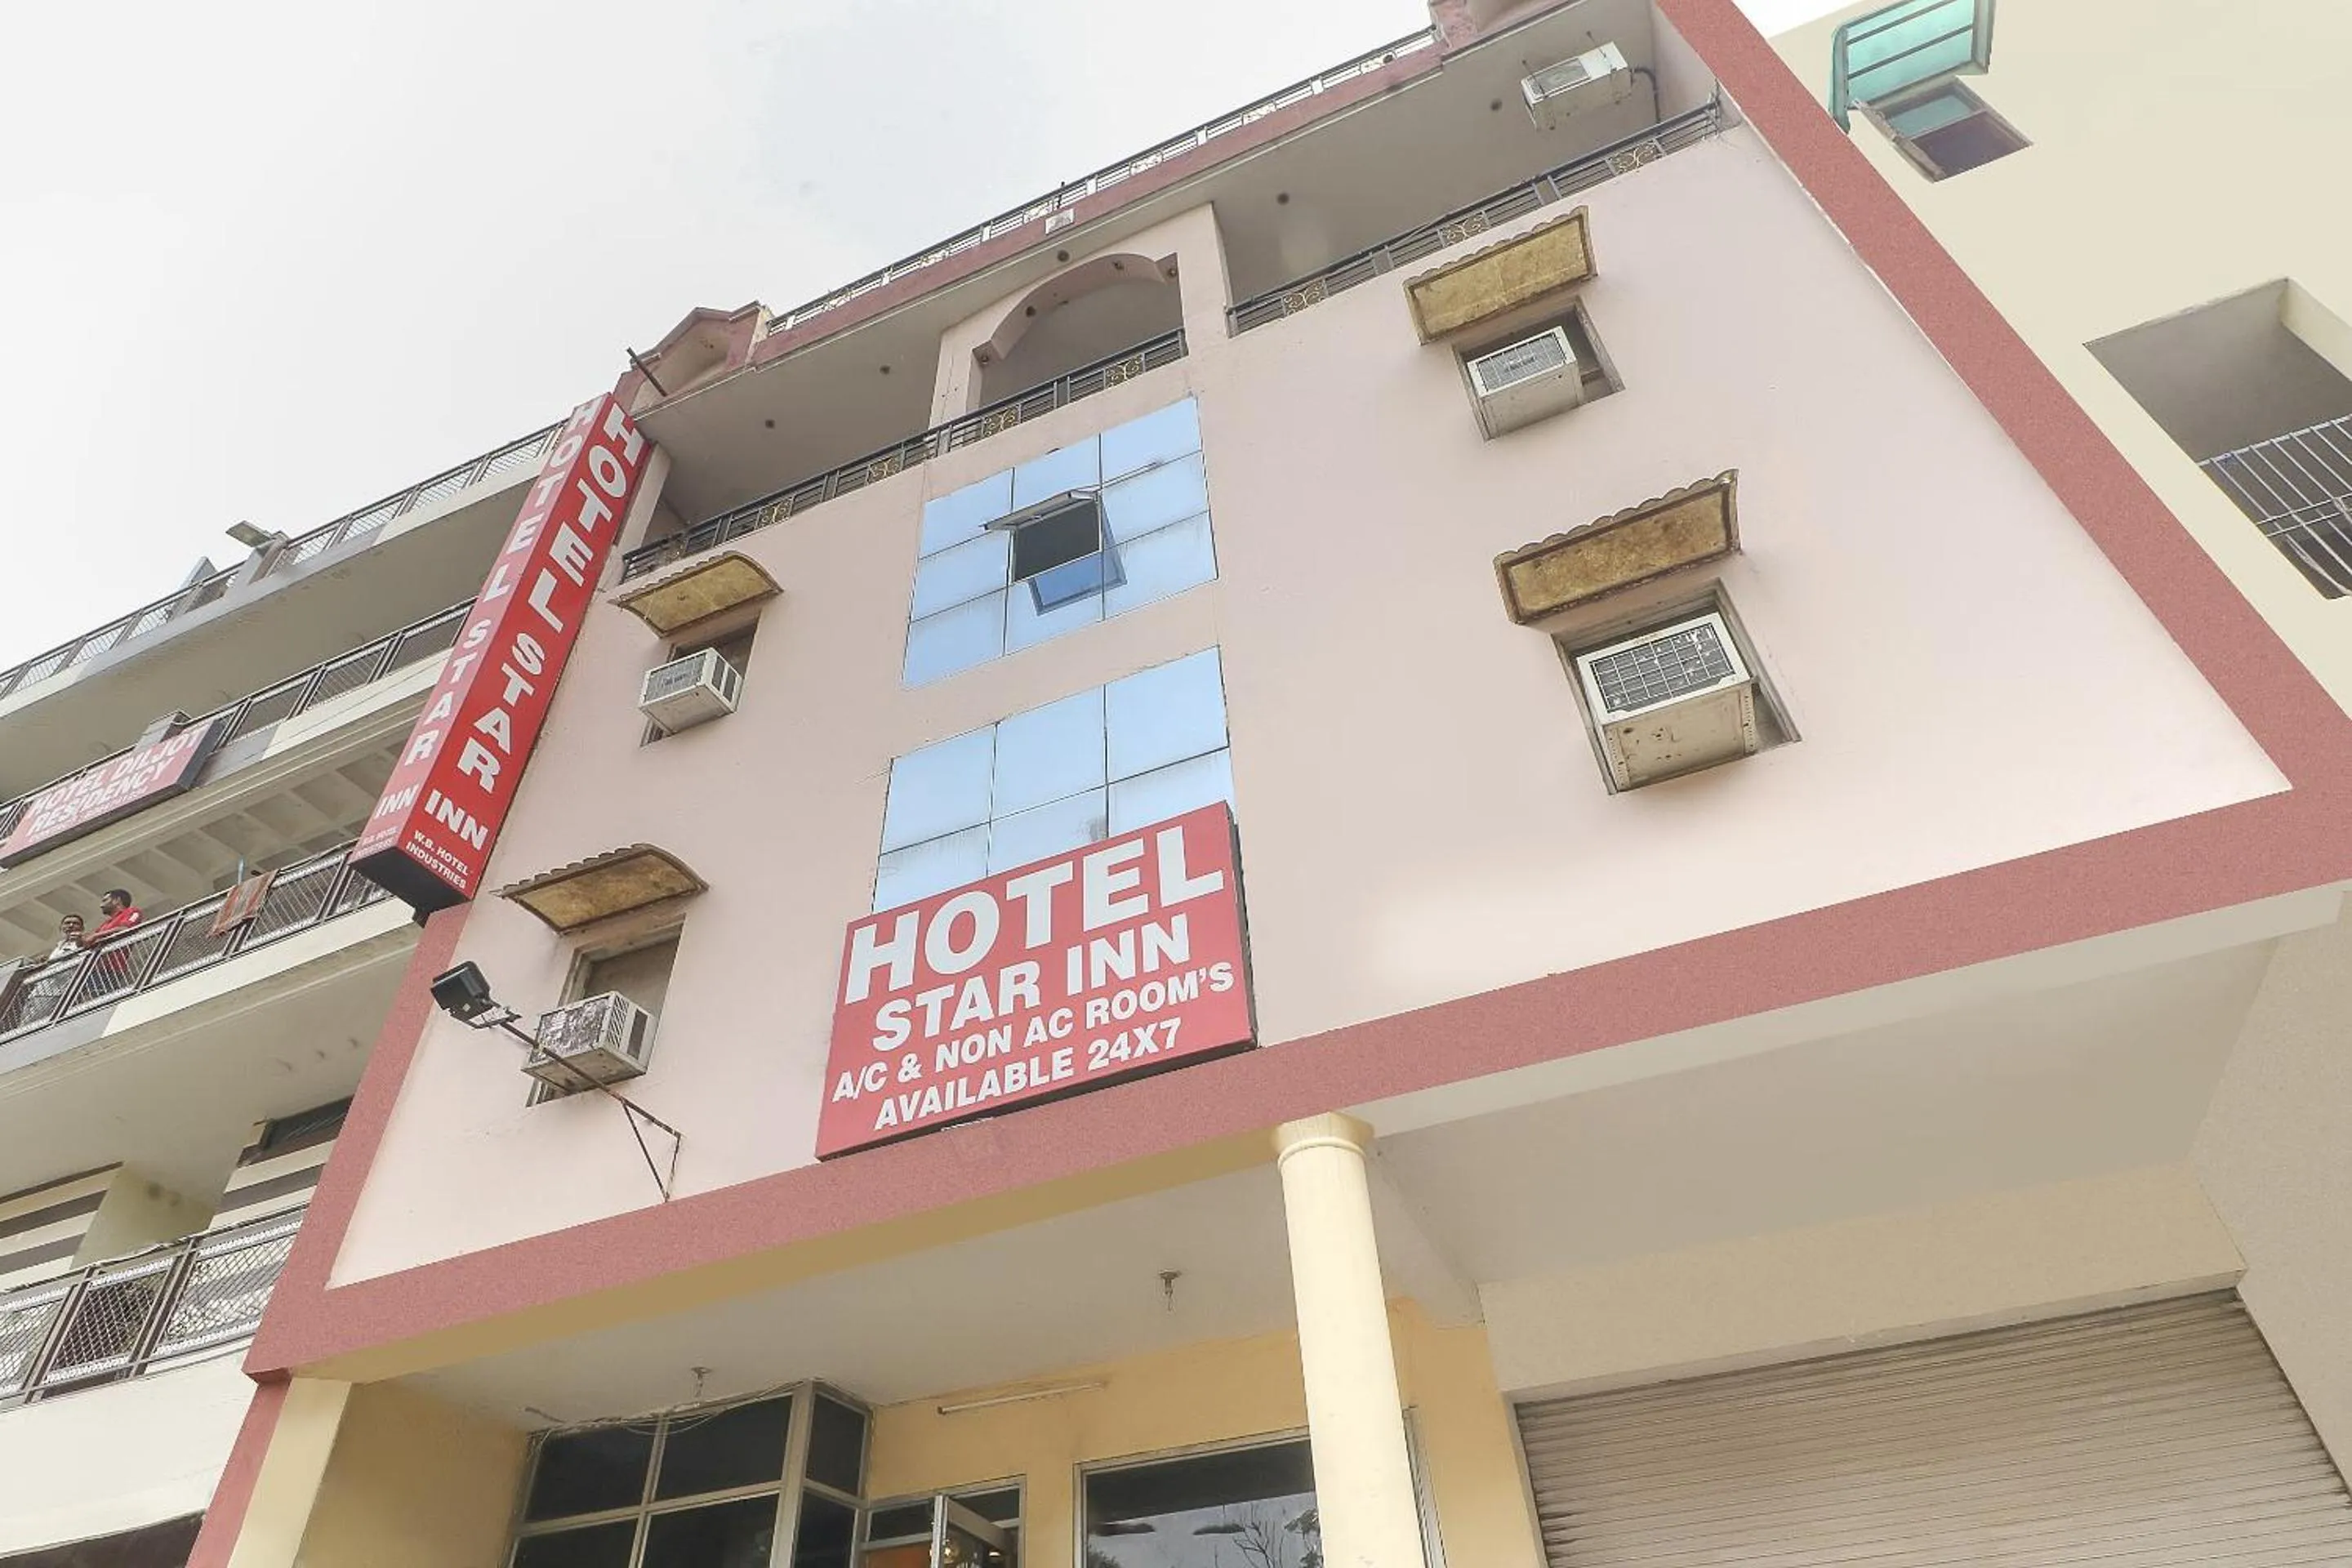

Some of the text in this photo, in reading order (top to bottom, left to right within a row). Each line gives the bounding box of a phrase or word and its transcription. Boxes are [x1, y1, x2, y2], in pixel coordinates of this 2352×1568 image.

[404, 396, 603, 766] HOTEL STAR
[457, 402, 645, 794] HOTEL STAR
[374, 783, 421, 819] INN
[424, 789, 488, 851] INN
[436, 845, 470, 876] HOTEL
[405, 840, 467, 890] INDUSTRIES
[844, 825, 1225, 1004] HOTEL
[831, 962, 1235, 1102] A/C & NON AC ROOM'S
[871, 913, 1191, 1052] STAR INN
[874, 1018, 1182, 1131] AVAILABLE 24X7
